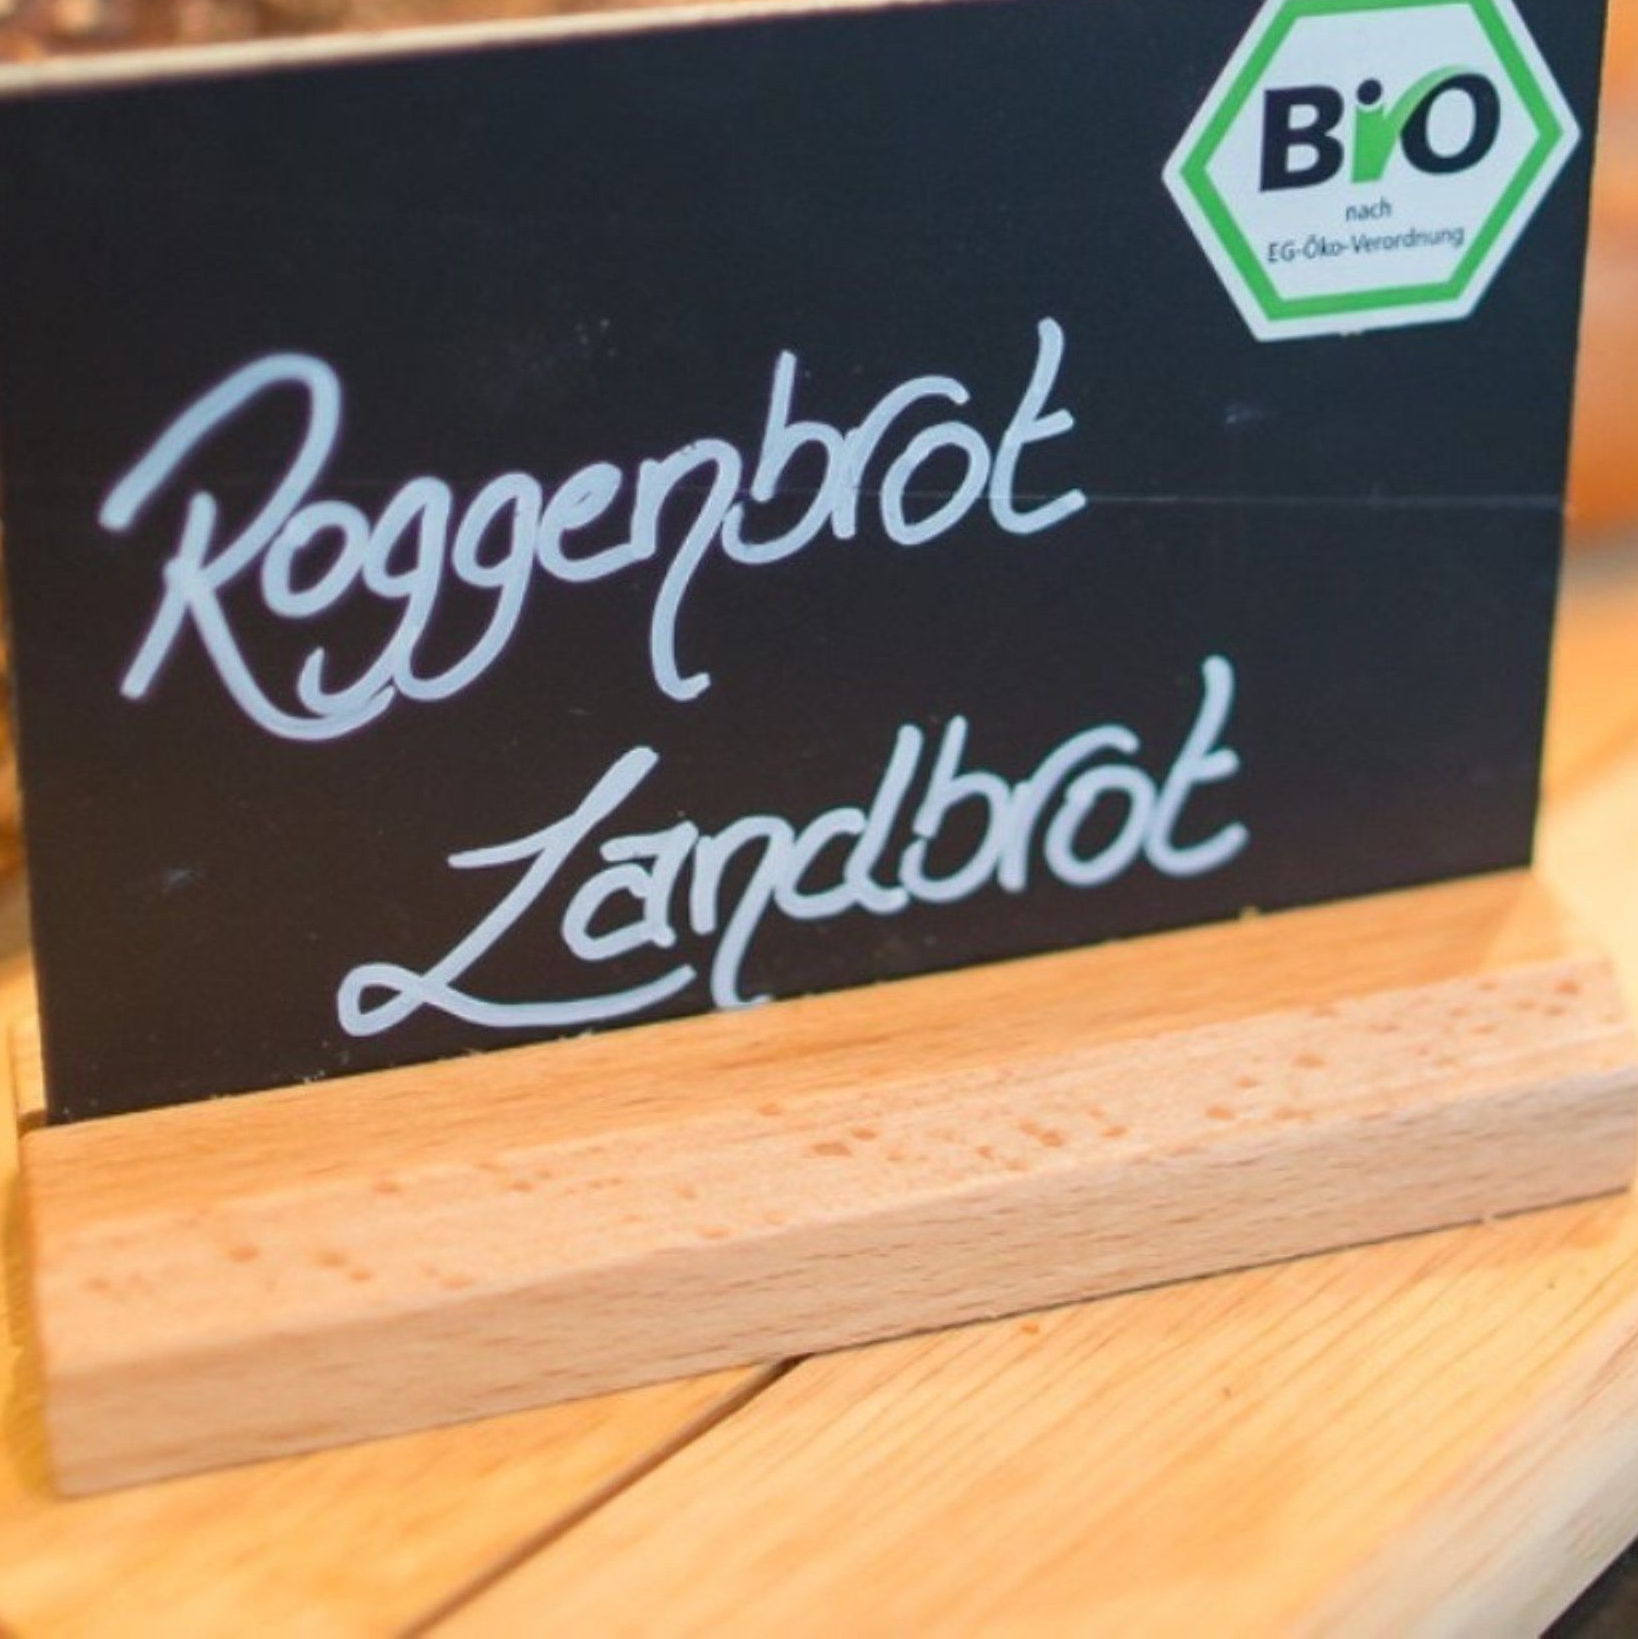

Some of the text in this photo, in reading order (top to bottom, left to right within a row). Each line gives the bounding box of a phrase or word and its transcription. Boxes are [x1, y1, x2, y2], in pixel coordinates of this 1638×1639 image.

[1267, 227, 1464, 263] EG-Öko-Verordnung
[1345, 197, 1392, 222] nach
[99, 317, 1087, 741] Roggenbrot
[336, 655, 1248, 1037] Landbrot
